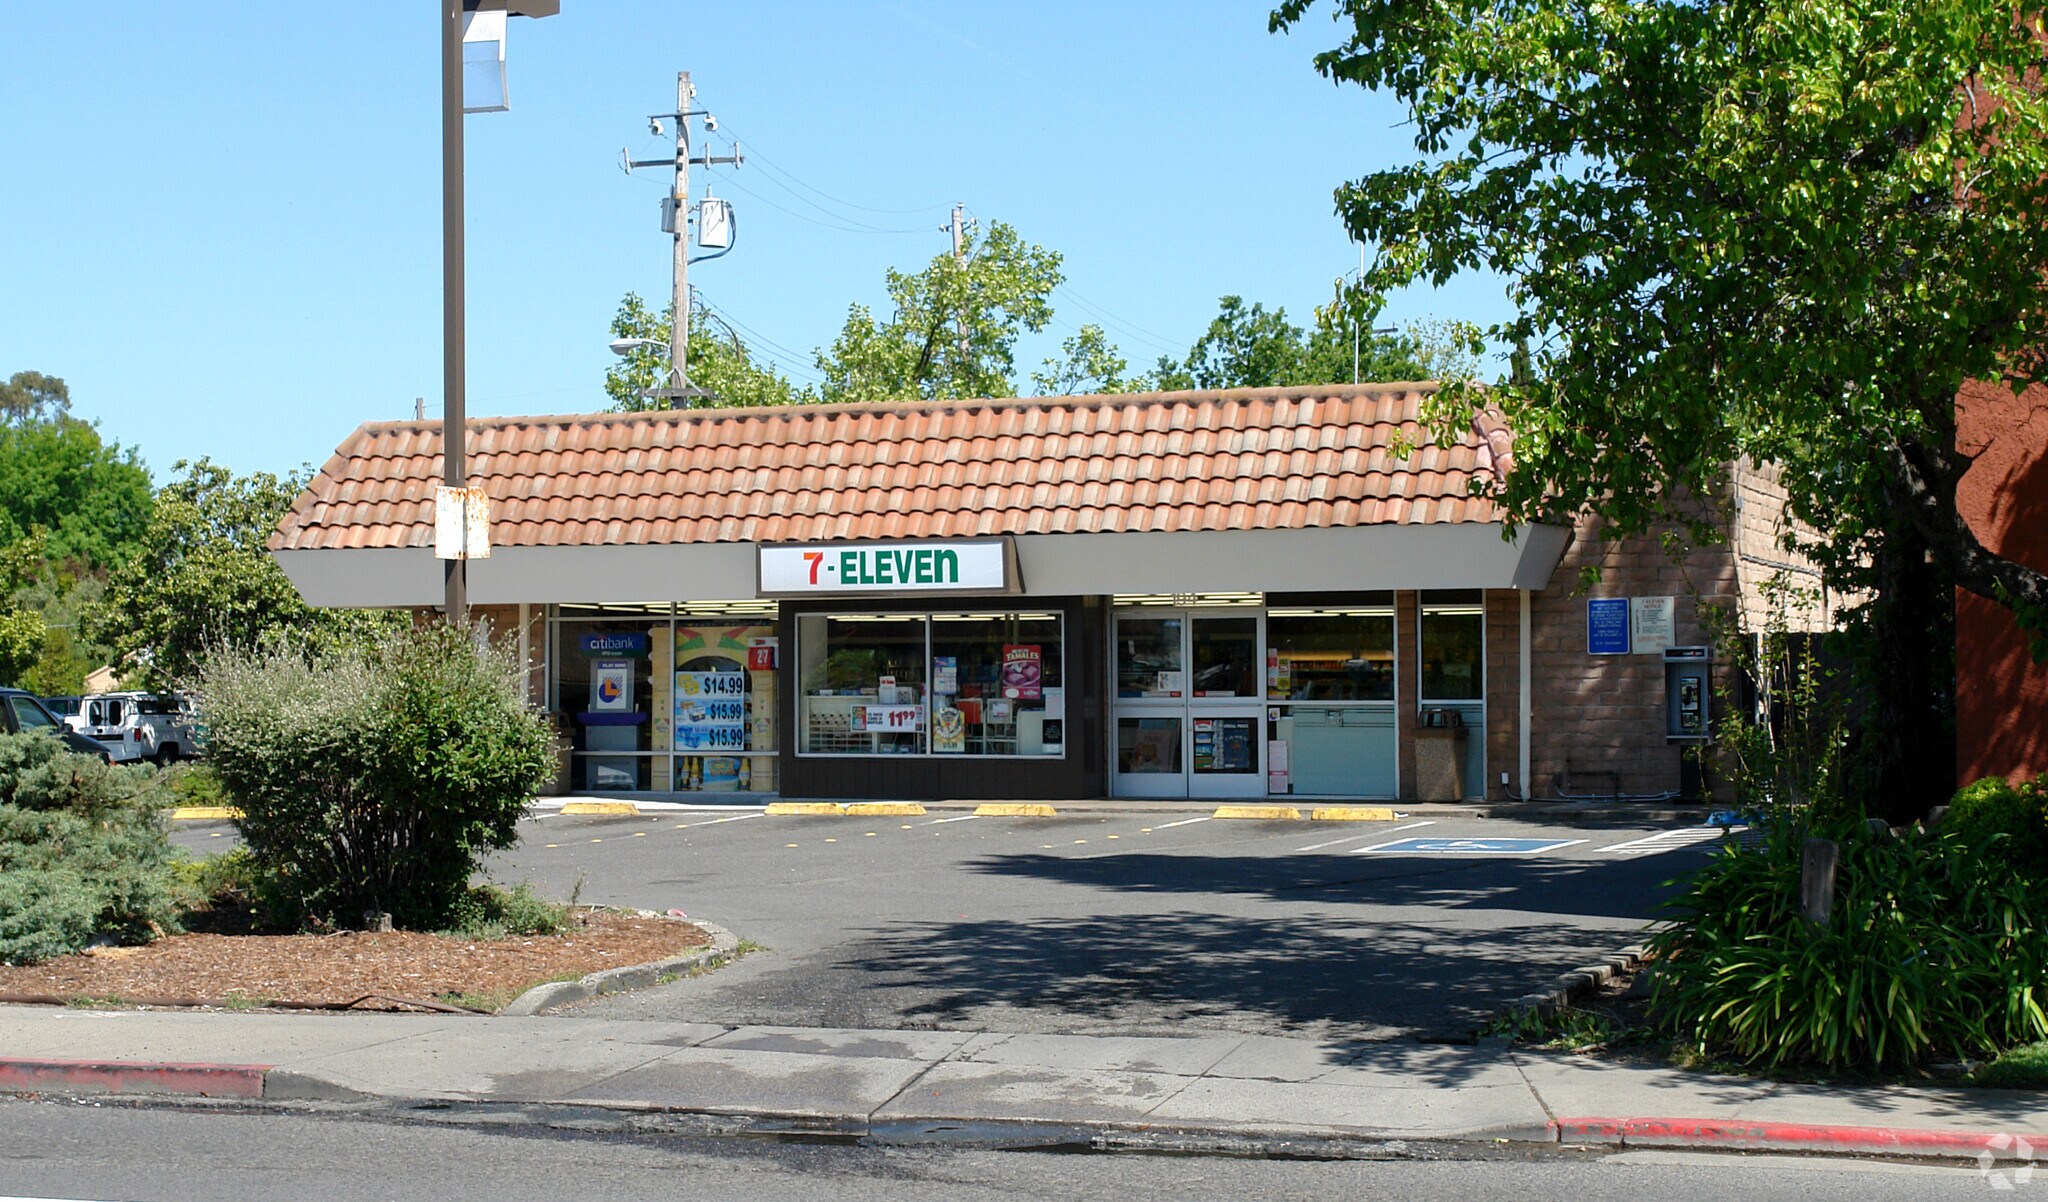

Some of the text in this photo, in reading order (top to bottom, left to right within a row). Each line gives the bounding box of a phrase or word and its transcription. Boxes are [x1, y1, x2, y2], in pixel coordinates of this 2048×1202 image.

[590, 636, 634, 649] citibank
[757, 649, 769, 664] 27
[704, 676, 743, 695] $14.99
[710, 703, 742, 721] $15.99
[709, 728, 743, 747] $15.99
